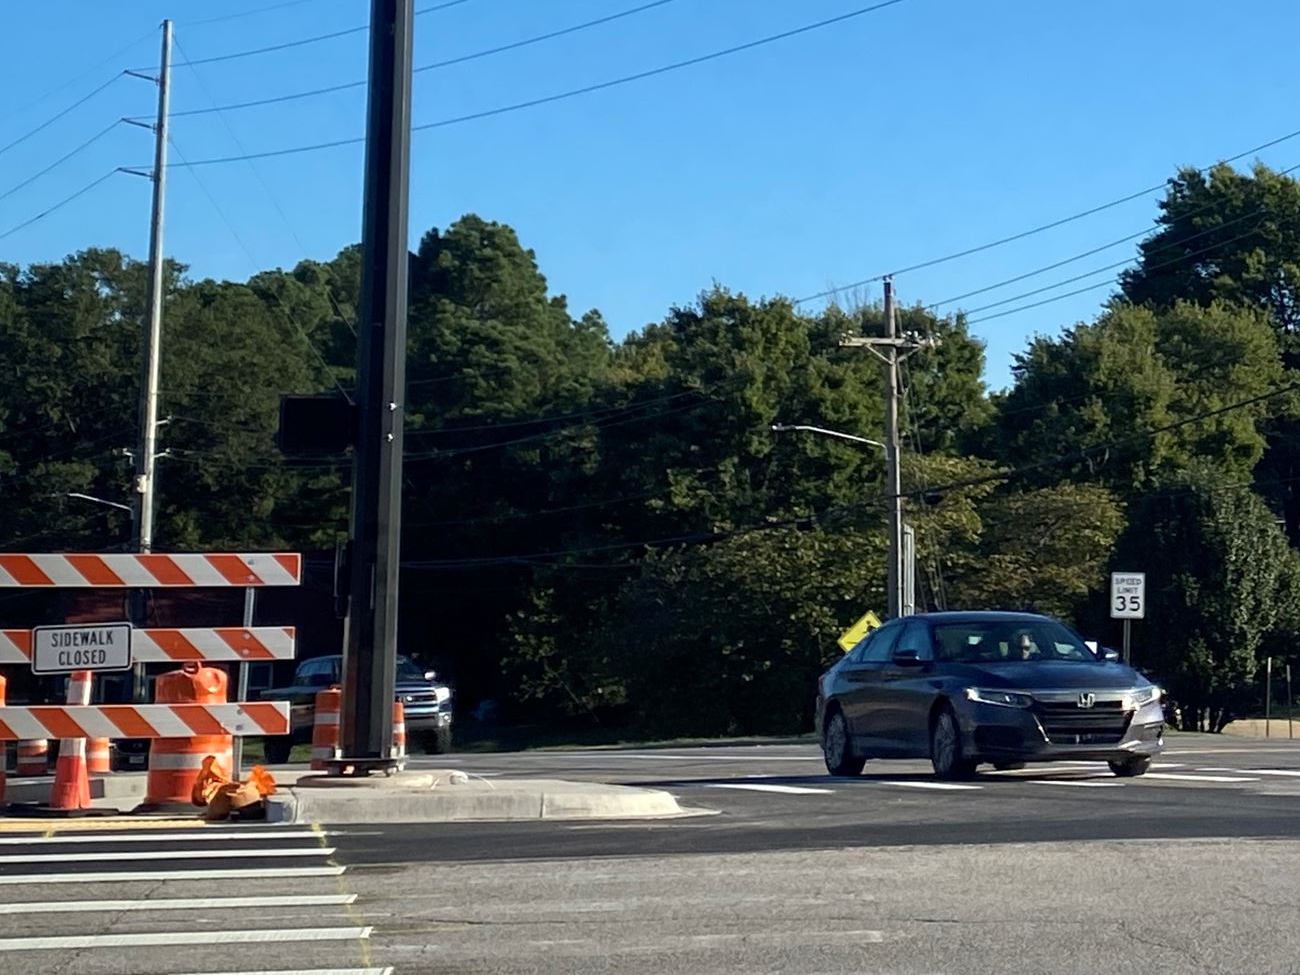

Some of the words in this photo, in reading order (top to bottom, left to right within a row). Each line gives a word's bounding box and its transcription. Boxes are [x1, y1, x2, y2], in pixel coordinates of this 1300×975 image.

[1114, 577, 1142, 585] SPEED
[1115, 595, 1141, 612] 35
[51, 630, 114, 647] SIDEWALK
[58, 649, 106, 666] CLOSED
